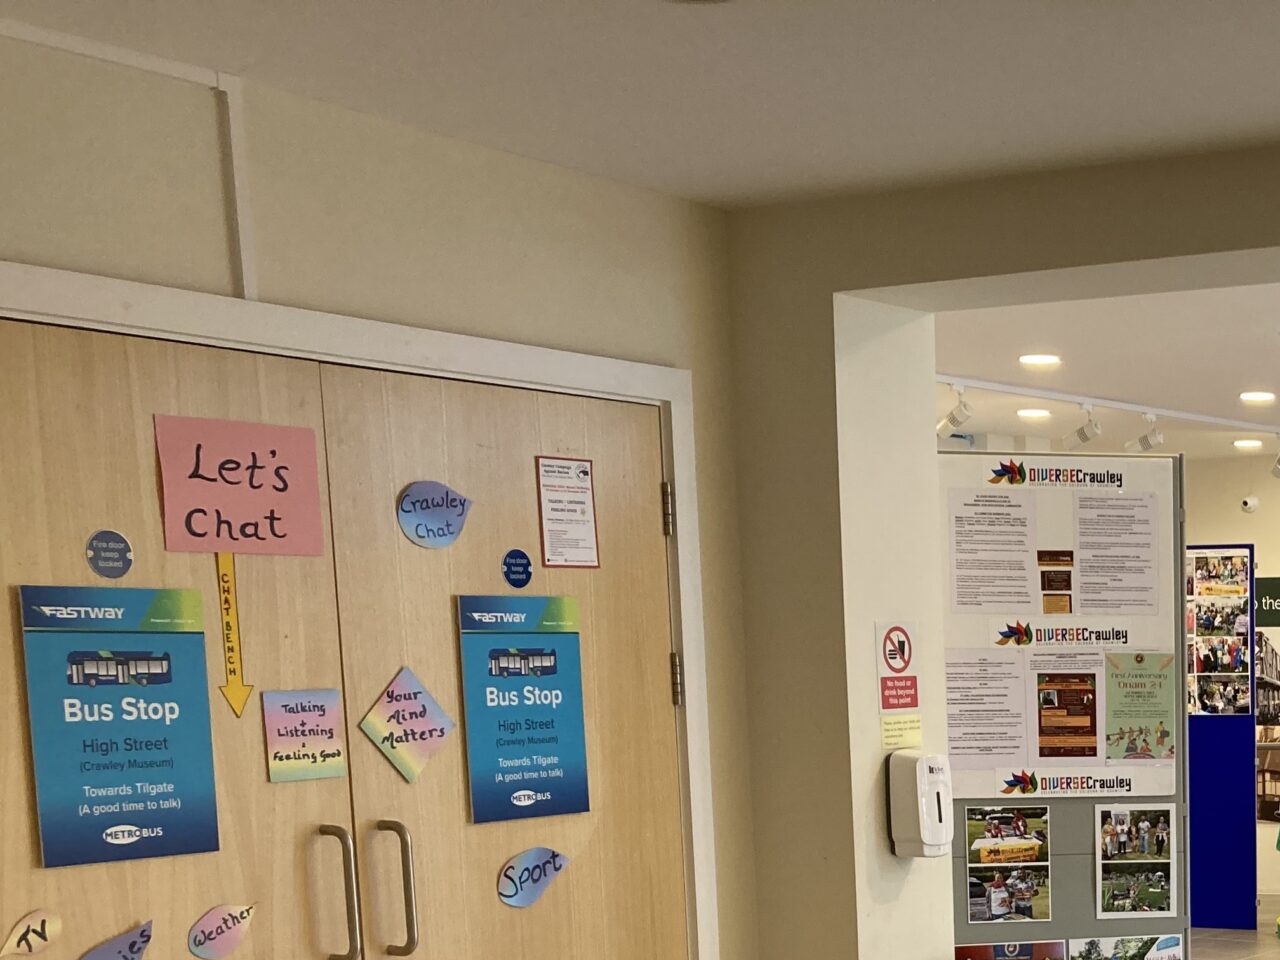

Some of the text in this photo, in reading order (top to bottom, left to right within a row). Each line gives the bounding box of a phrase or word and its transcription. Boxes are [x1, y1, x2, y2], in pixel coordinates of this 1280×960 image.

[187, 443, 290, 493] Let's
[400, 494, 467, 517] Crawley
[184, 507, 288, 541] Chat
[415, 520, 455, 540] Chat
[221, 573, 233, 616] CHAT
[225, 621, 237, 676] BENCH
[386, 689, 423, 704] Your
[485, 685, 563, 708] Bus Stop
[63, 697, 180, 725] Bus Stop
[281, 701, 326, 716] Talking
[386, 704, 427, 726] Mind
[277, 725, 334, 739] Listening
[498, 718, 555, 733] High Street
[83, 737, 168, 757] High Street
[381, 727, 446, 750] Matters
[80, 758, 174, 773] (Crawley Museum)
[273, 749, 341, 763] Feeling Good
[498, 754, 559, 768] Towards Tilgate
[504, 771, 522, 782] good
[523, 769, 539, 780] time
[540, 769, 548, 779] to
[83, 782, 175, 798] Towards Tilgate
[512, 791, 551, 803] METROBUS
[79, 798, 182, 816] (A good time to talk)
[104, 827, 163, 841] METROBUS
[498, 850, 562, 899] Sport
[16, 918, 48, 953] TV
[193, 906, 253, 948] Weather
